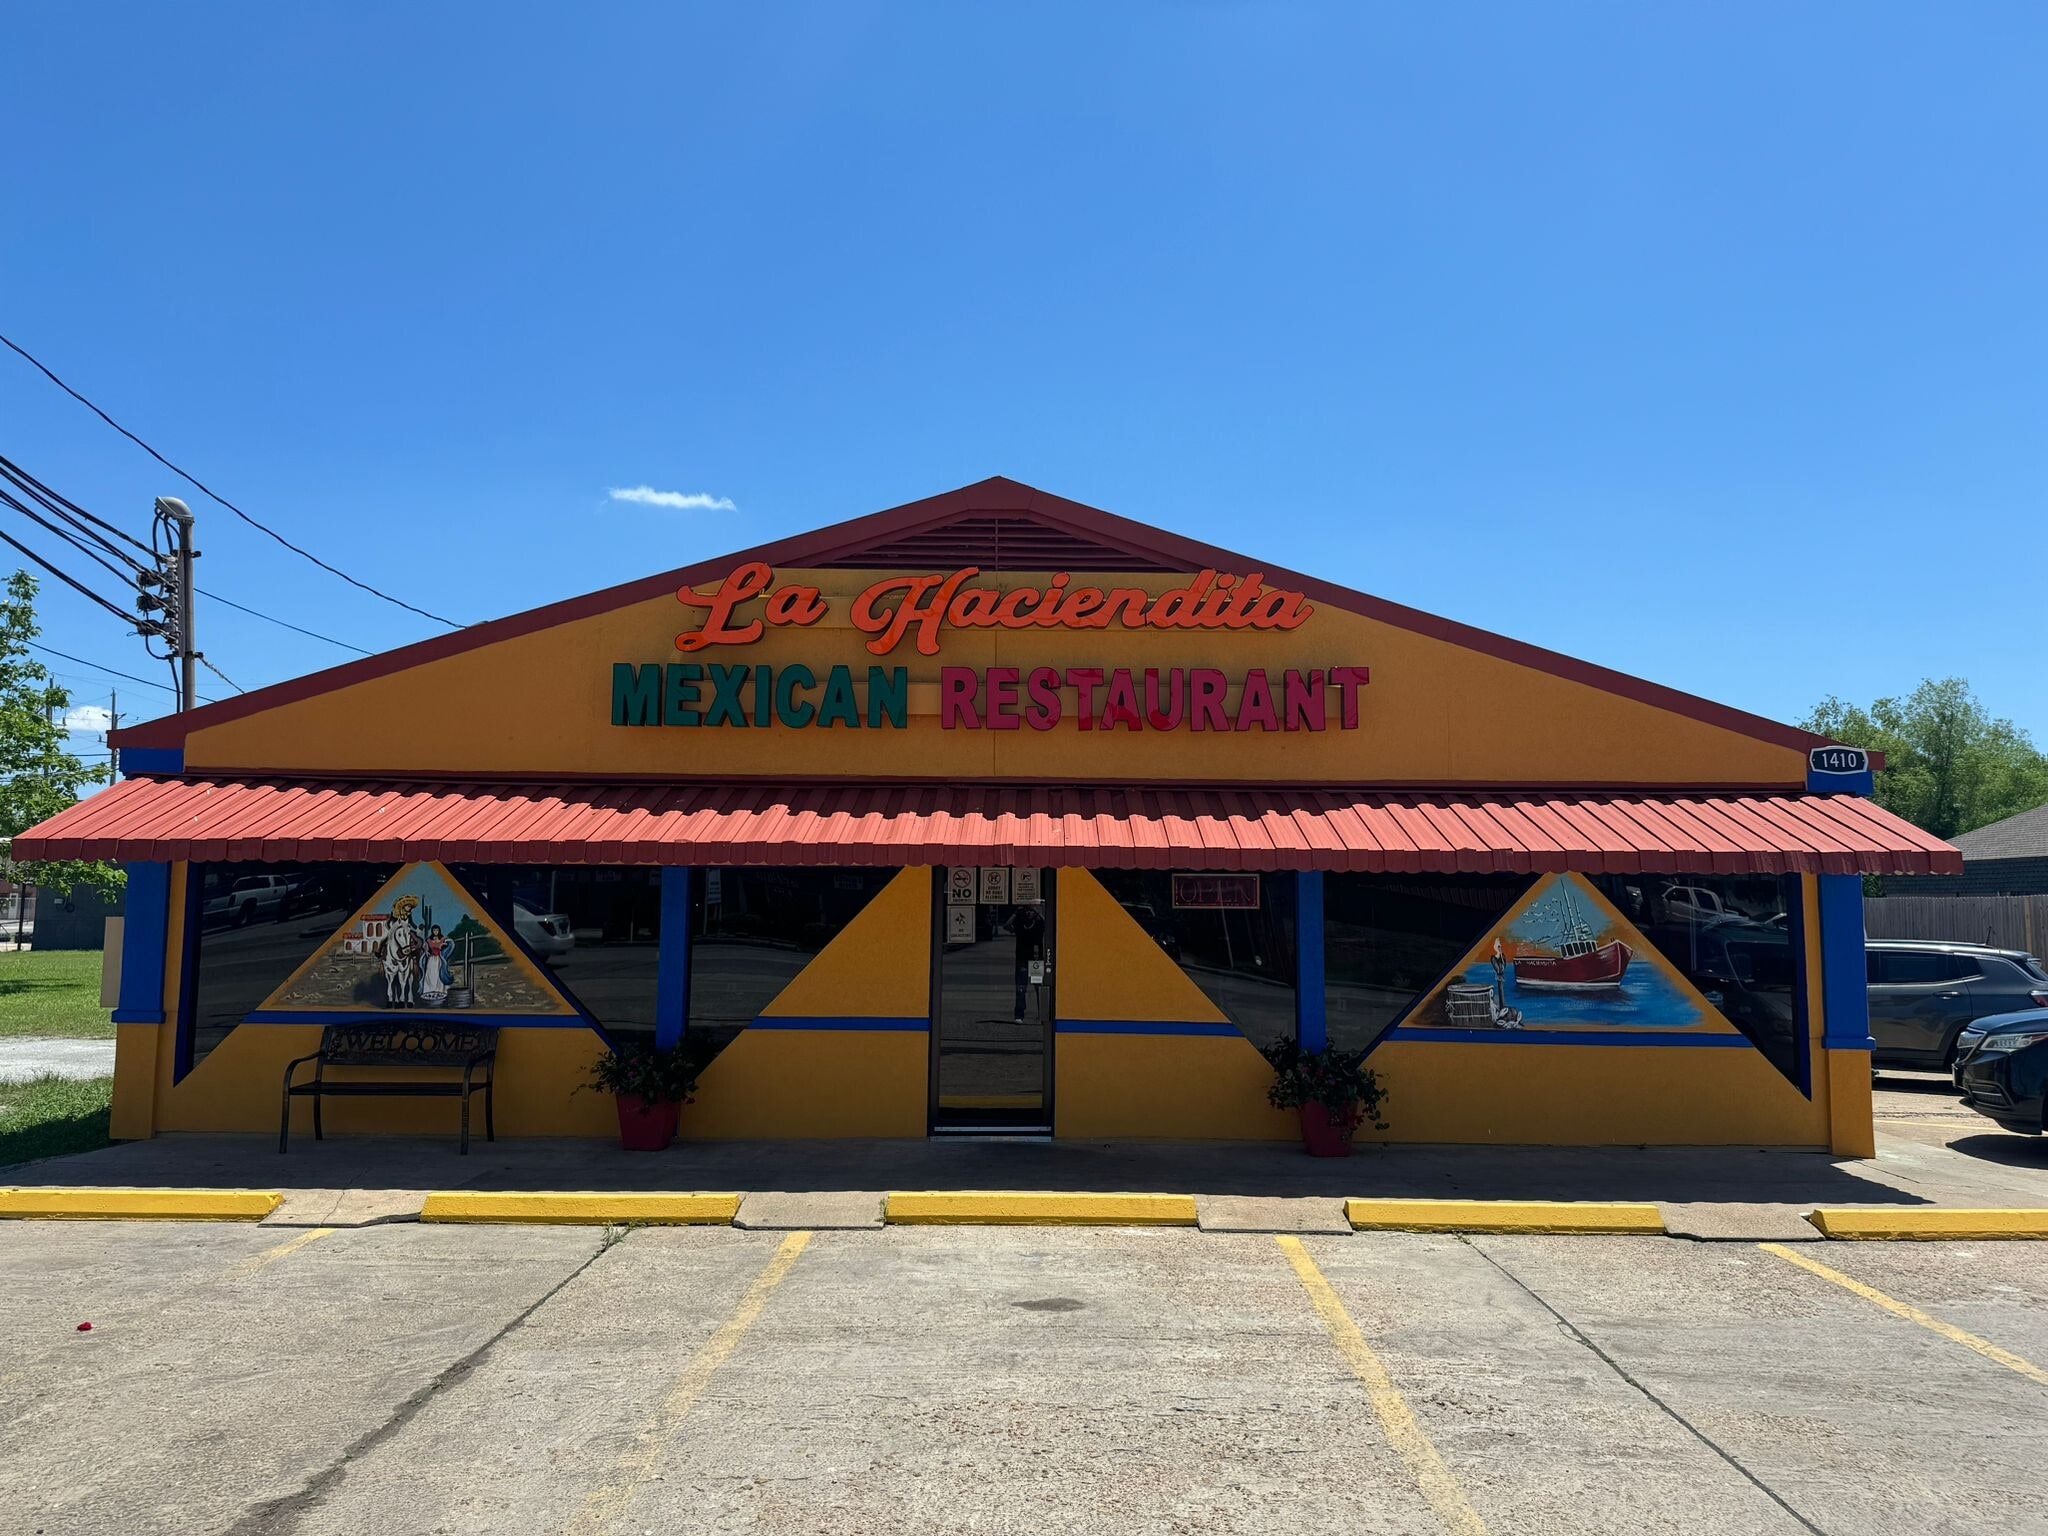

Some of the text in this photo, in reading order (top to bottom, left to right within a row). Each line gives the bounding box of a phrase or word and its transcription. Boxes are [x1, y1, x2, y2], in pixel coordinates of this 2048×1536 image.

[674, 561, 1315, 656] La Haciendita
[612, 663, 1370, 732] MEXICAN RESTAURANT
[1821, 752, 1857, 768] 1410
[952, 888, 972, 898] NO
[346, 1032, 480, 1051] WELCOME
